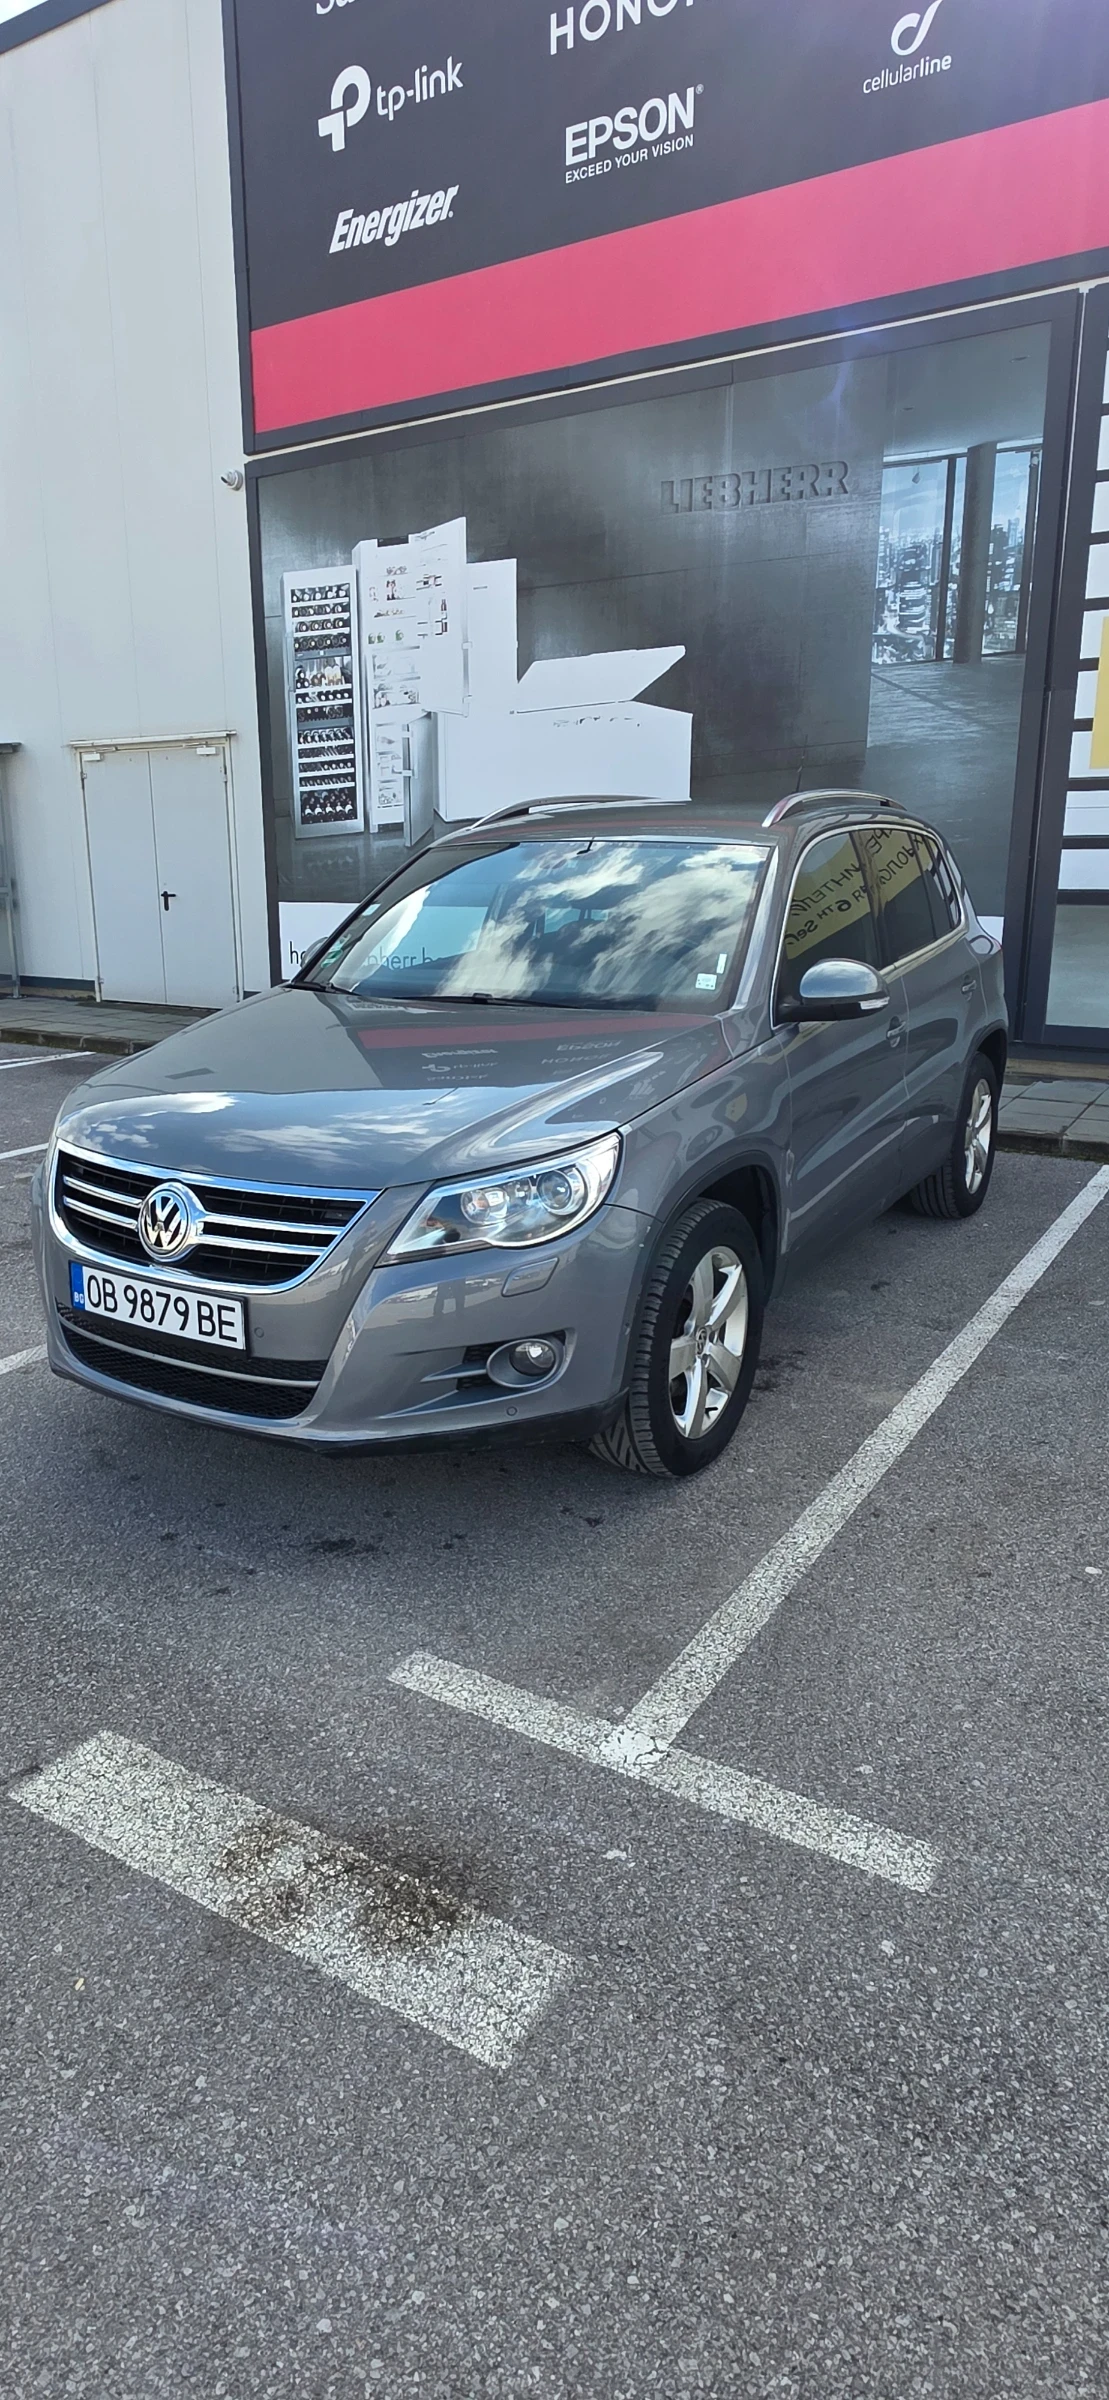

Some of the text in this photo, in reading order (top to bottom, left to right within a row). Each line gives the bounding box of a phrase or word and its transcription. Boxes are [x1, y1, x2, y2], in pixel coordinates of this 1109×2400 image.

[376, 56, 464, 121] tp-link
[862, 54, 952, 94] cellularline
[565, 133, 694, 184] EXCEED YOUR VISION
[660, 460, 849, 514] LIEBHERR
[73, 1274, 238, 1343] BG OB 9879 BE
